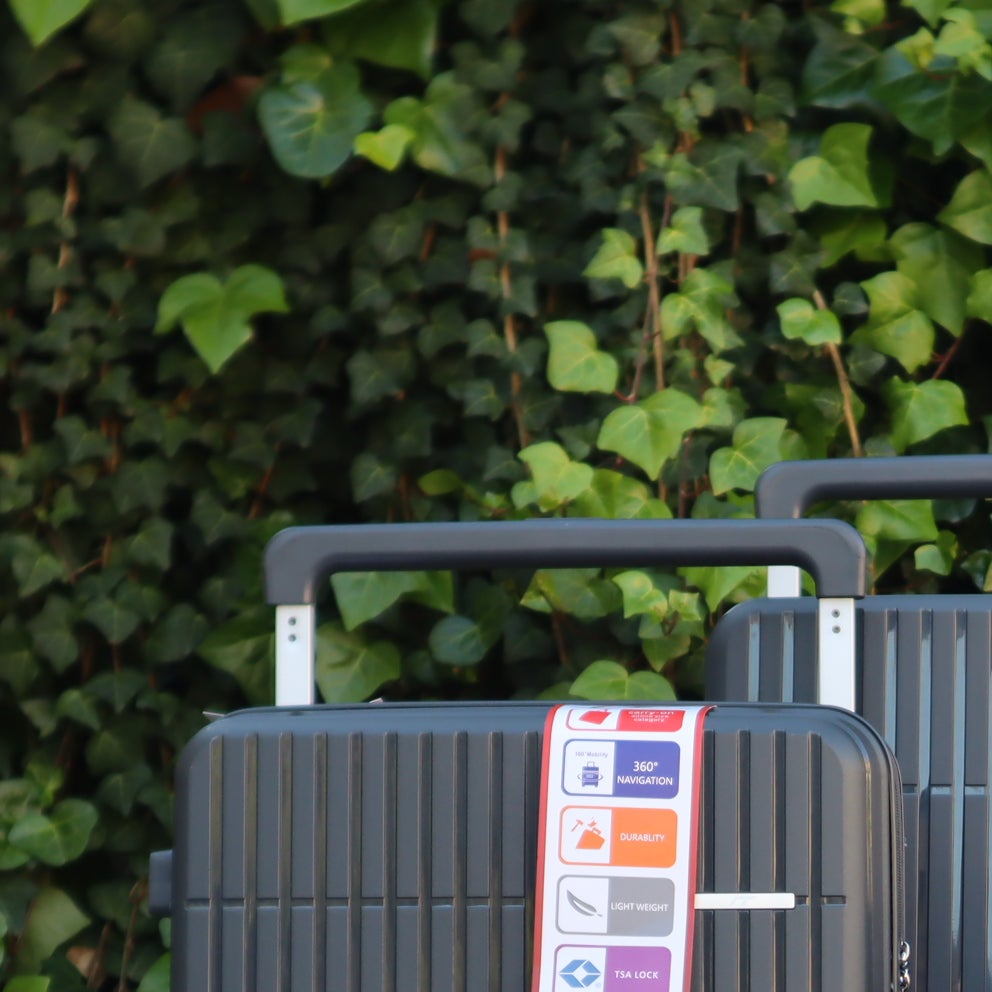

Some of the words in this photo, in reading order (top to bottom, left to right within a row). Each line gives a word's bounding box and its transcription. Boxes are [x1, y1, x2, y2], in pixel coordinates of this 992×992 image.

[633, 761, 658, 772] 360°
[617, 775, 673, 786] NAVIGATION
[620, 832, 665, 842] DURABLITY
[610, 902, 634, 911] LIGHT
[636, 903, 669, 912] WEIGHT
[614, 970, 632, 979] TSA
[634, 970, 658, 979] LOCK
